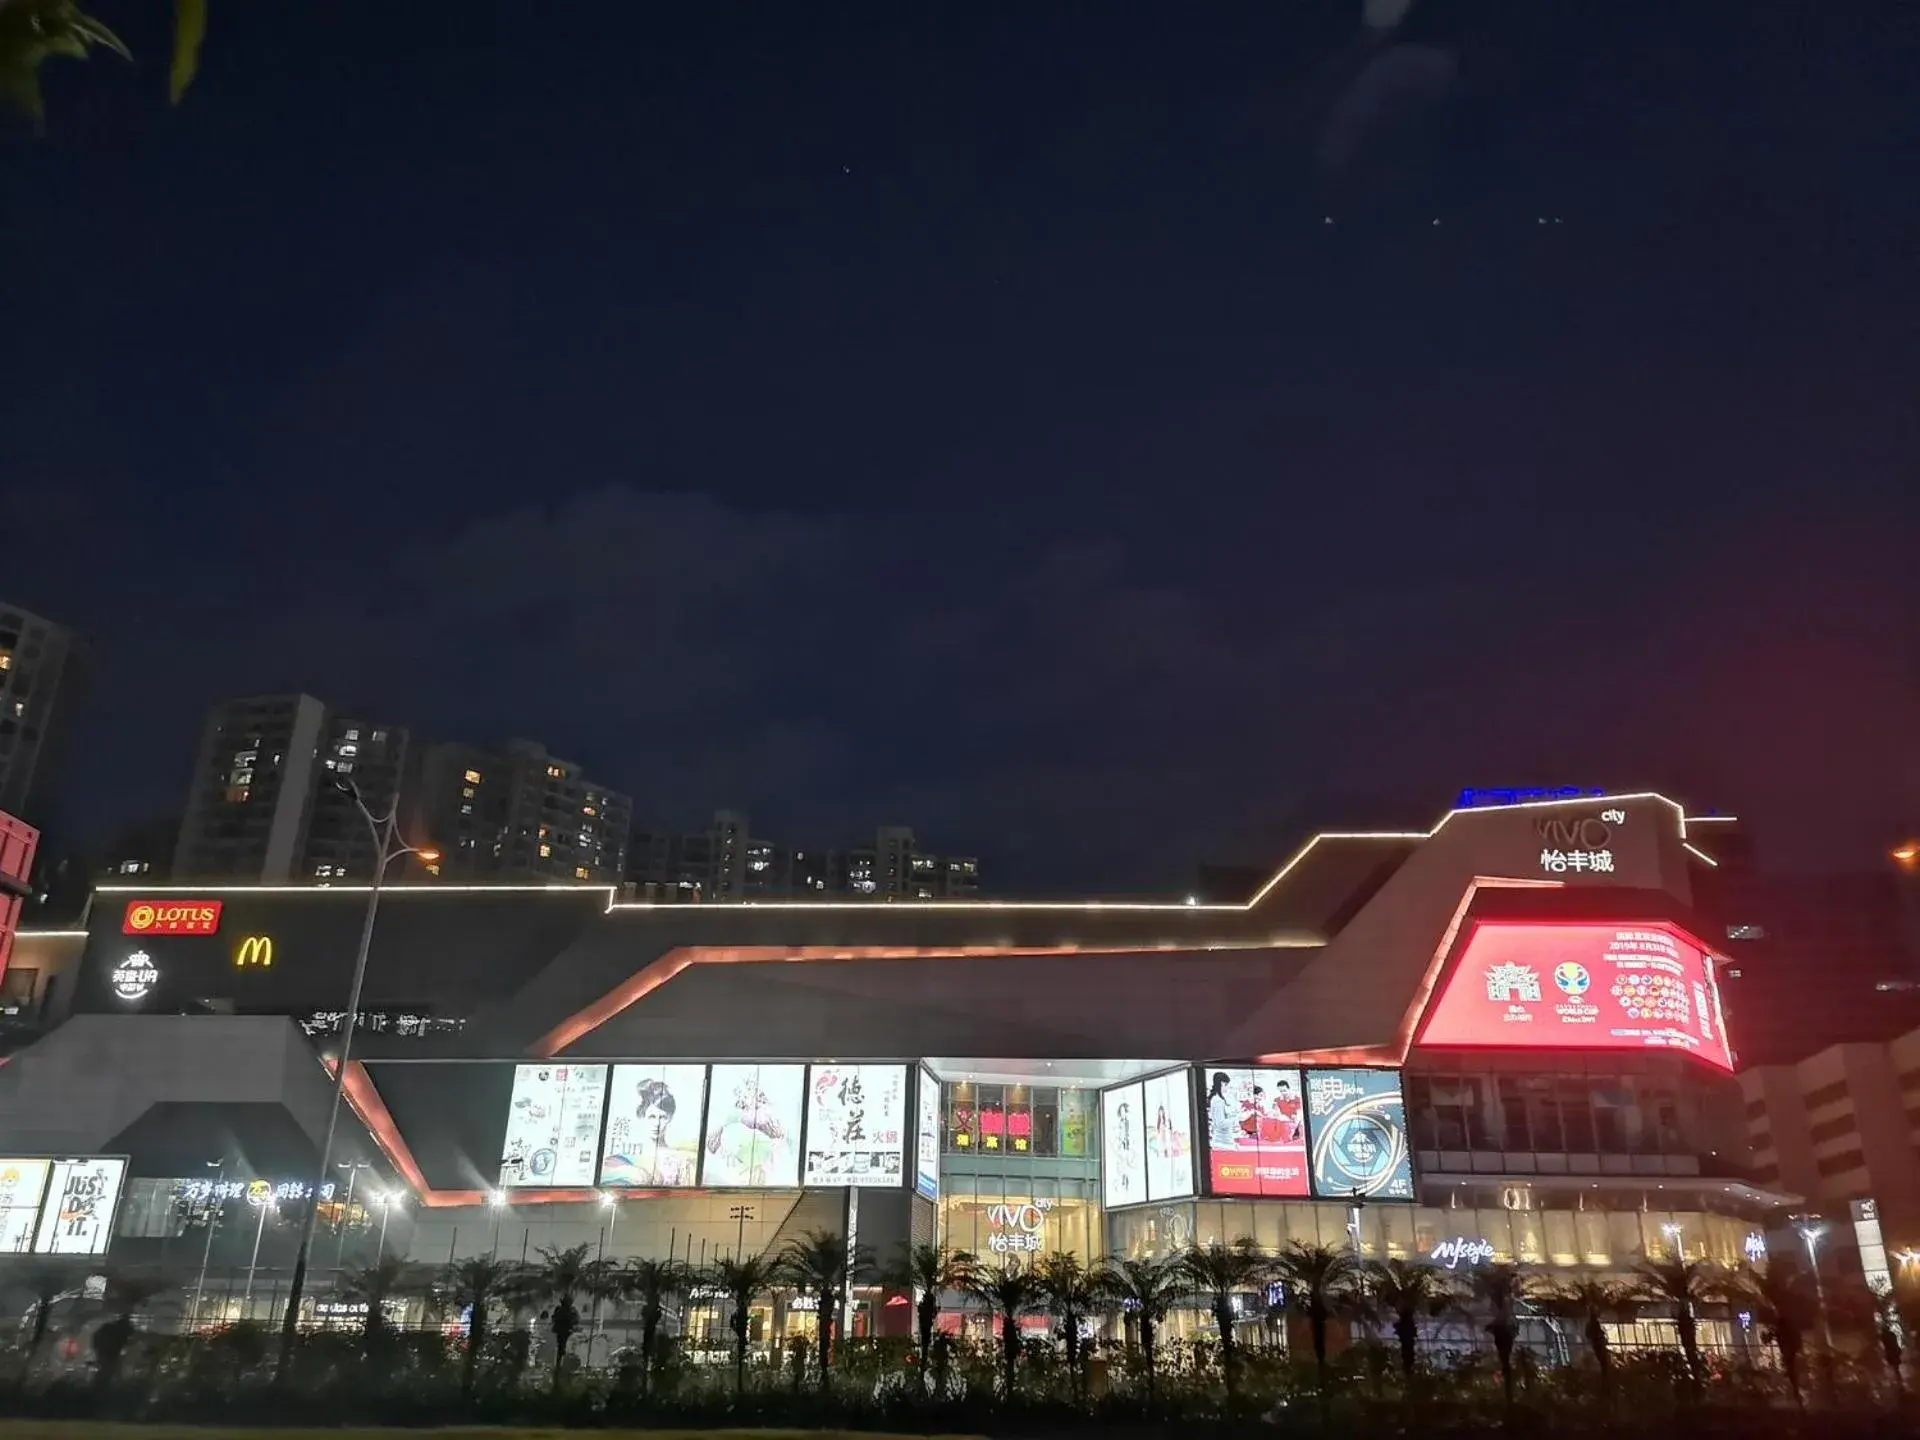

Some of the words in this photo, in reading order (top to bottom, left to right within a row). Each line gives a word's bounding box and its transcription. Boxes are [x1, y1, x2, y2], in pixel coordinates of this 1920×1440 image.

[1601, 808, 1626, 824] city
[1540, 849, 1615, 873] 怡丰城
[155, 906, 215, 922] LOTUS
[986, 1204, 1044, 1232] VIVO
[987, 1232, 1046, 1252] 怡丰城
